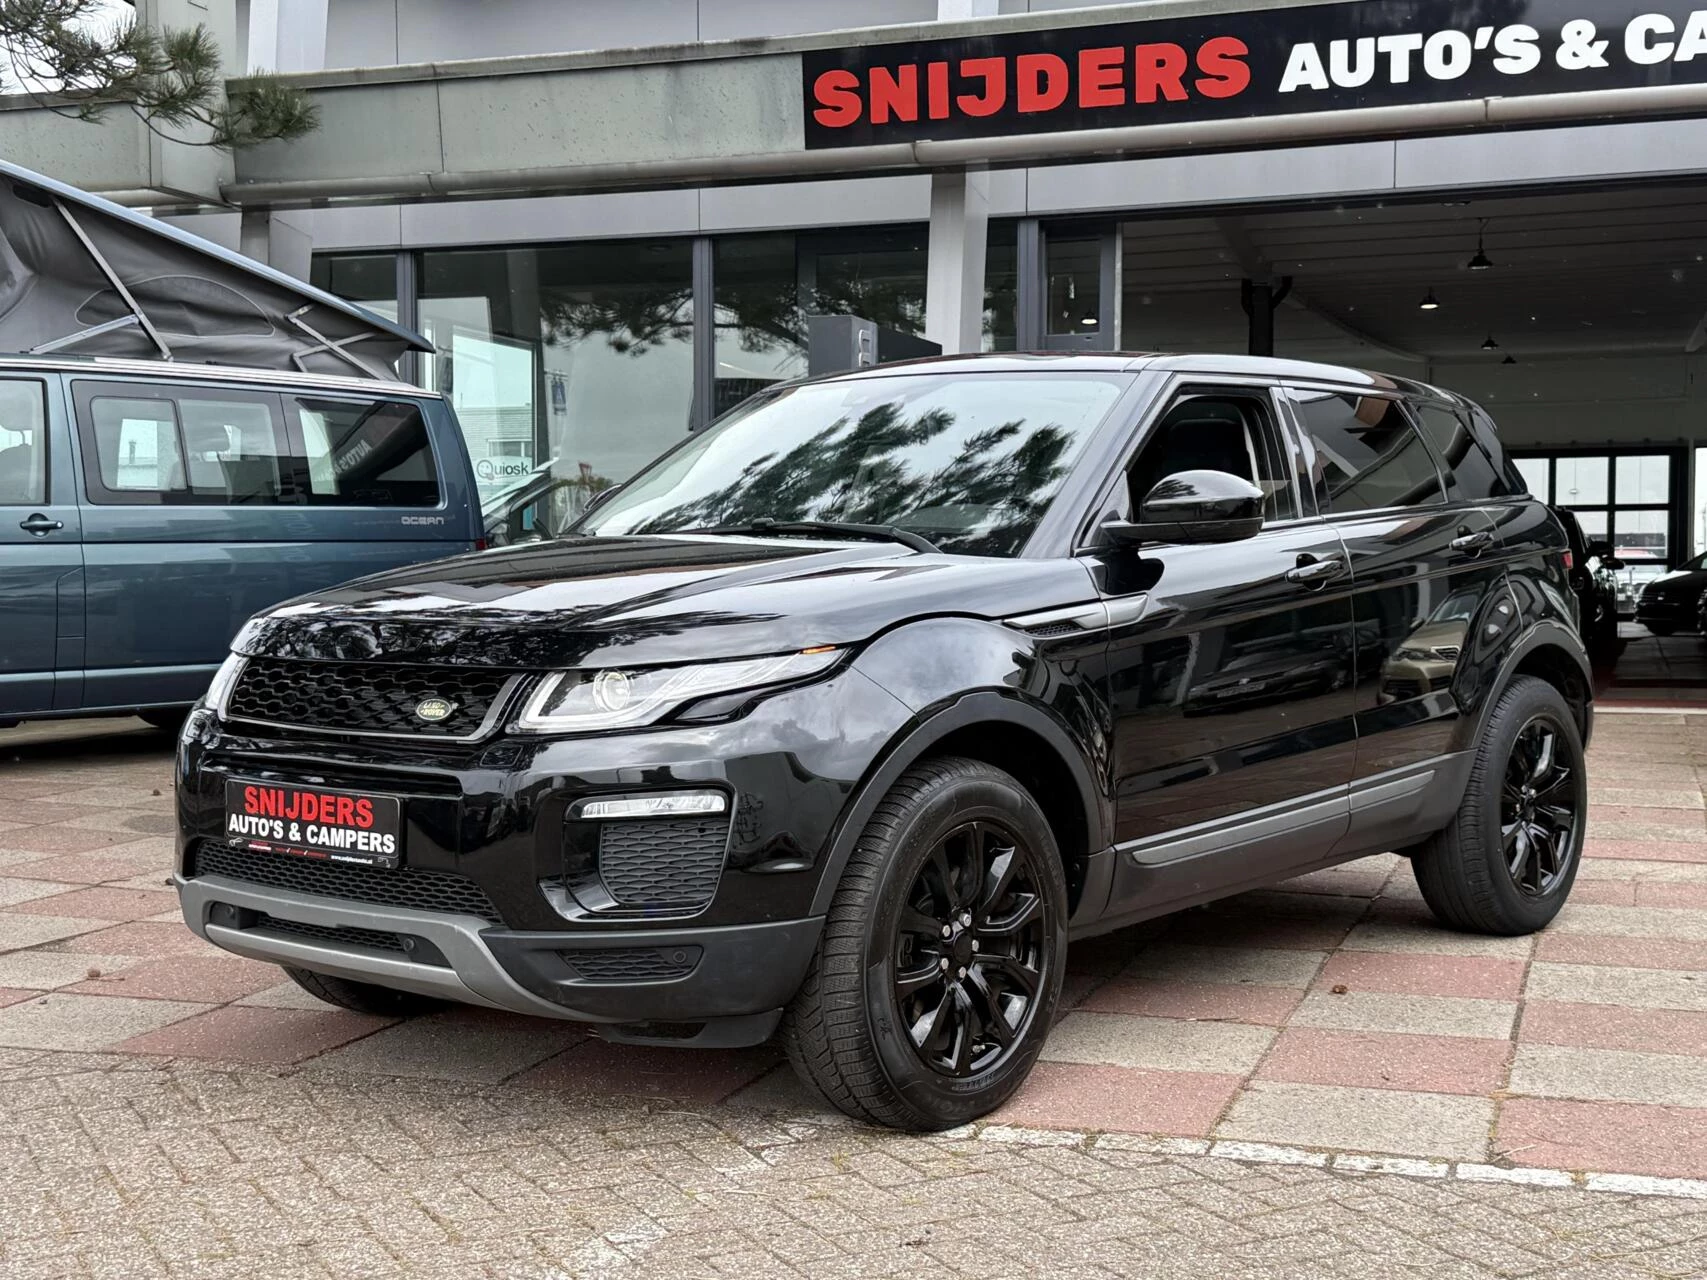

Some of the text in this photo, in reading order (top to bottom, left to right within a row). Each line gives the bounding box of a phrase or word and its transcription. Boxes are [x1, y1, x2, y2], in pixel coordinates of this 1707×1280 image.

[813, 10, 1707, 128] SNIJDERS AUTO'S & CA
[477, 459, 530, 480] Quiosk
[401, 516, 445, 525] OCEAN
[244, 786, 374, 828] SNIJDERS
[228, 814, 284, 840] AUTO'S
[289, 823, 302, 842] &
[306, 823, 396, 854] CAMPERS
